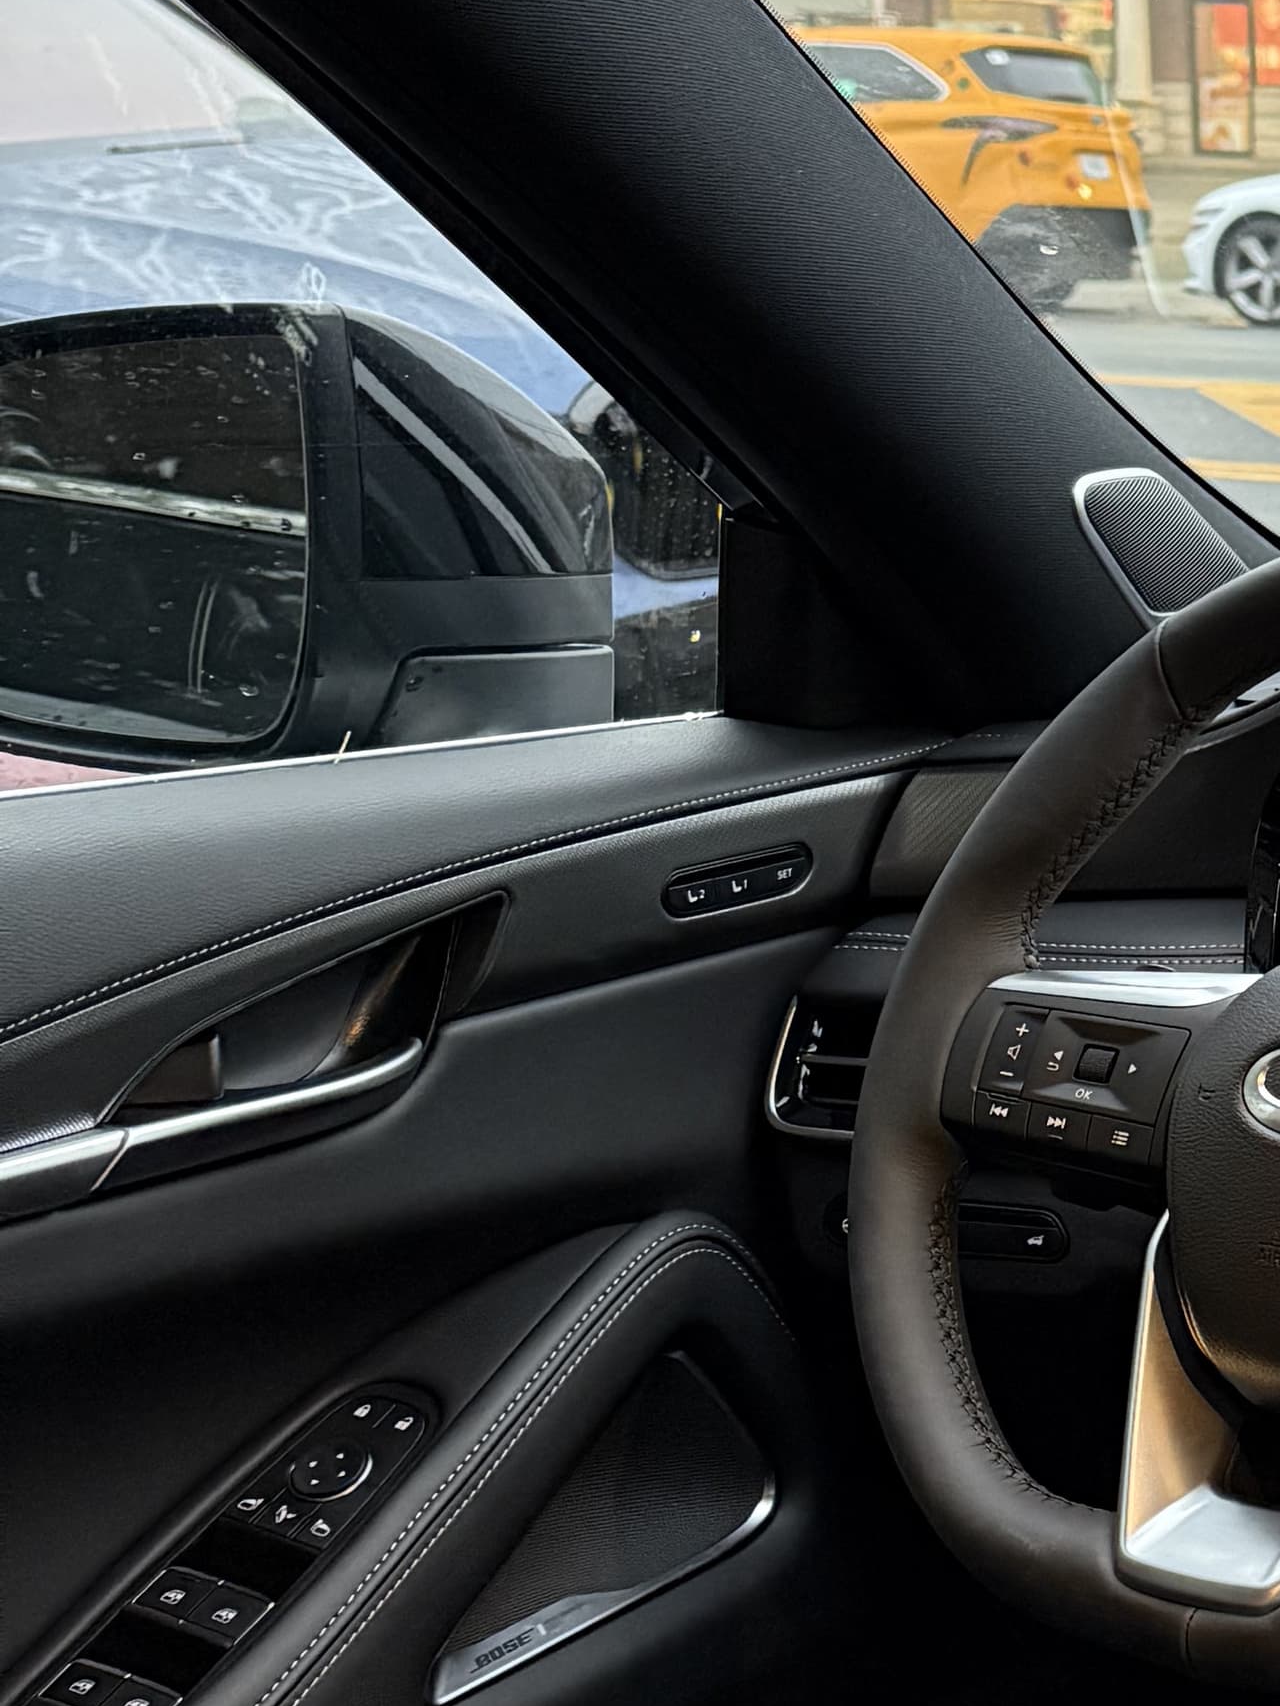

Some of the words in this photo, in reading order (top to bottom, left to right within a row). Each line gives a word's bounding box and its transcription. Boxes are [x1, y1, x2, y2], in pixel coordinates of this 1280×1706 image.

[777, 868, 794, 881] SET
[1074, 1088, 1094, 1101] OK
[470, 1628, 535, 1674] BOSE
